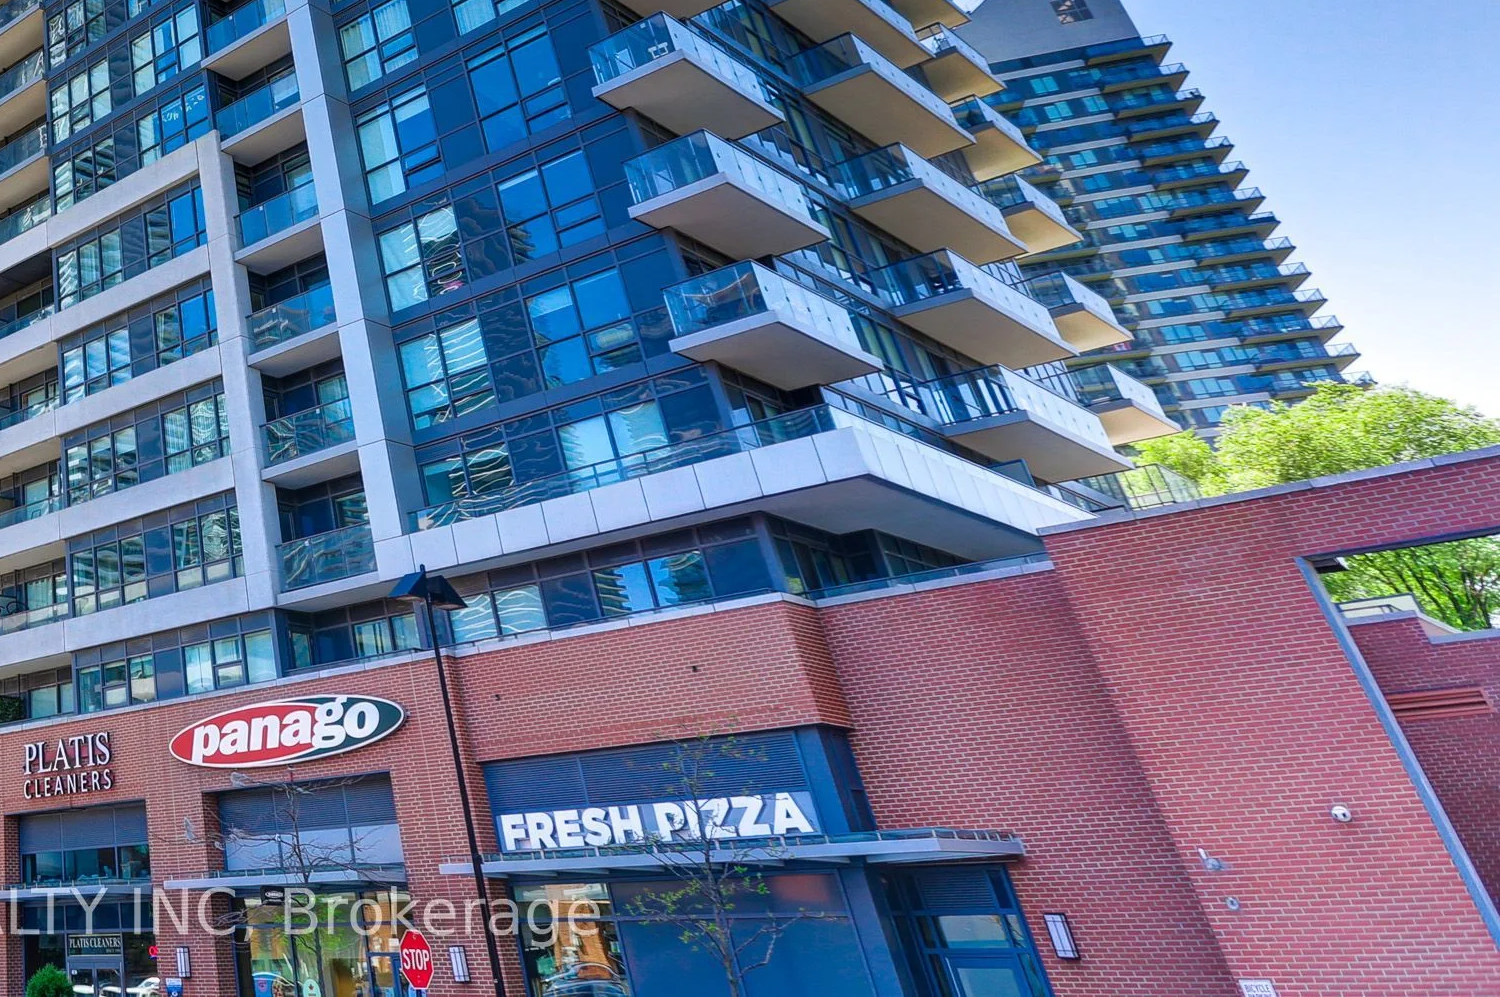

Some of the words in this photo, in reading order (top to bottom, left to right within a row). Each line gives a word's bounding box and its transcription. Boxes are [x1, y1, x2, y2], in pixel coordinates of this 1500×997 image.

[191, 696, 380, 764] panago
[23, 731, 111, 776] PLATIS
[23, 768, 113, 800] CLEANERS
[500, 805, 646, 851] FRESH
[651, 792, 815, 843] PIZZA
[69, 938, 89, 948] PLATIS
[90, 937, 121, 948] CLEANERS
[402, 948, 430, 971] STOP
